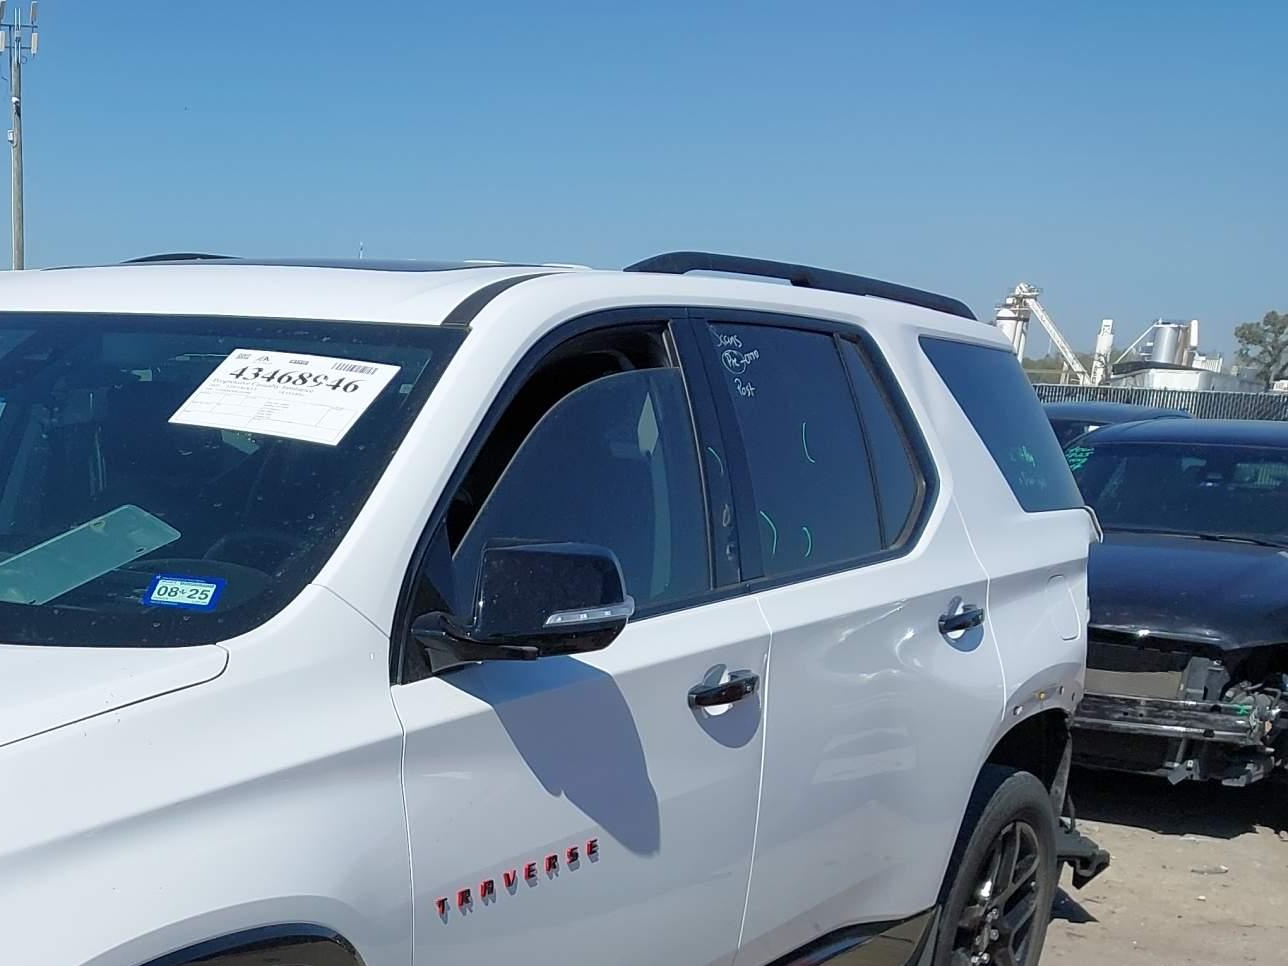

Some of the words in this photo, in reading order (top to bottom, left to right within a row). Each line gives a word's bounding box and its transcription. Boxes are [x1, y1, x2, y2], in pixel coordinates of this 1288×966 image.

[229, 366, 366, 393] 43468946
[157, 585, 180, 597] 08
[187, 588, 211, 600] 25
[435, 837, 600, 916] TRAVERSE
